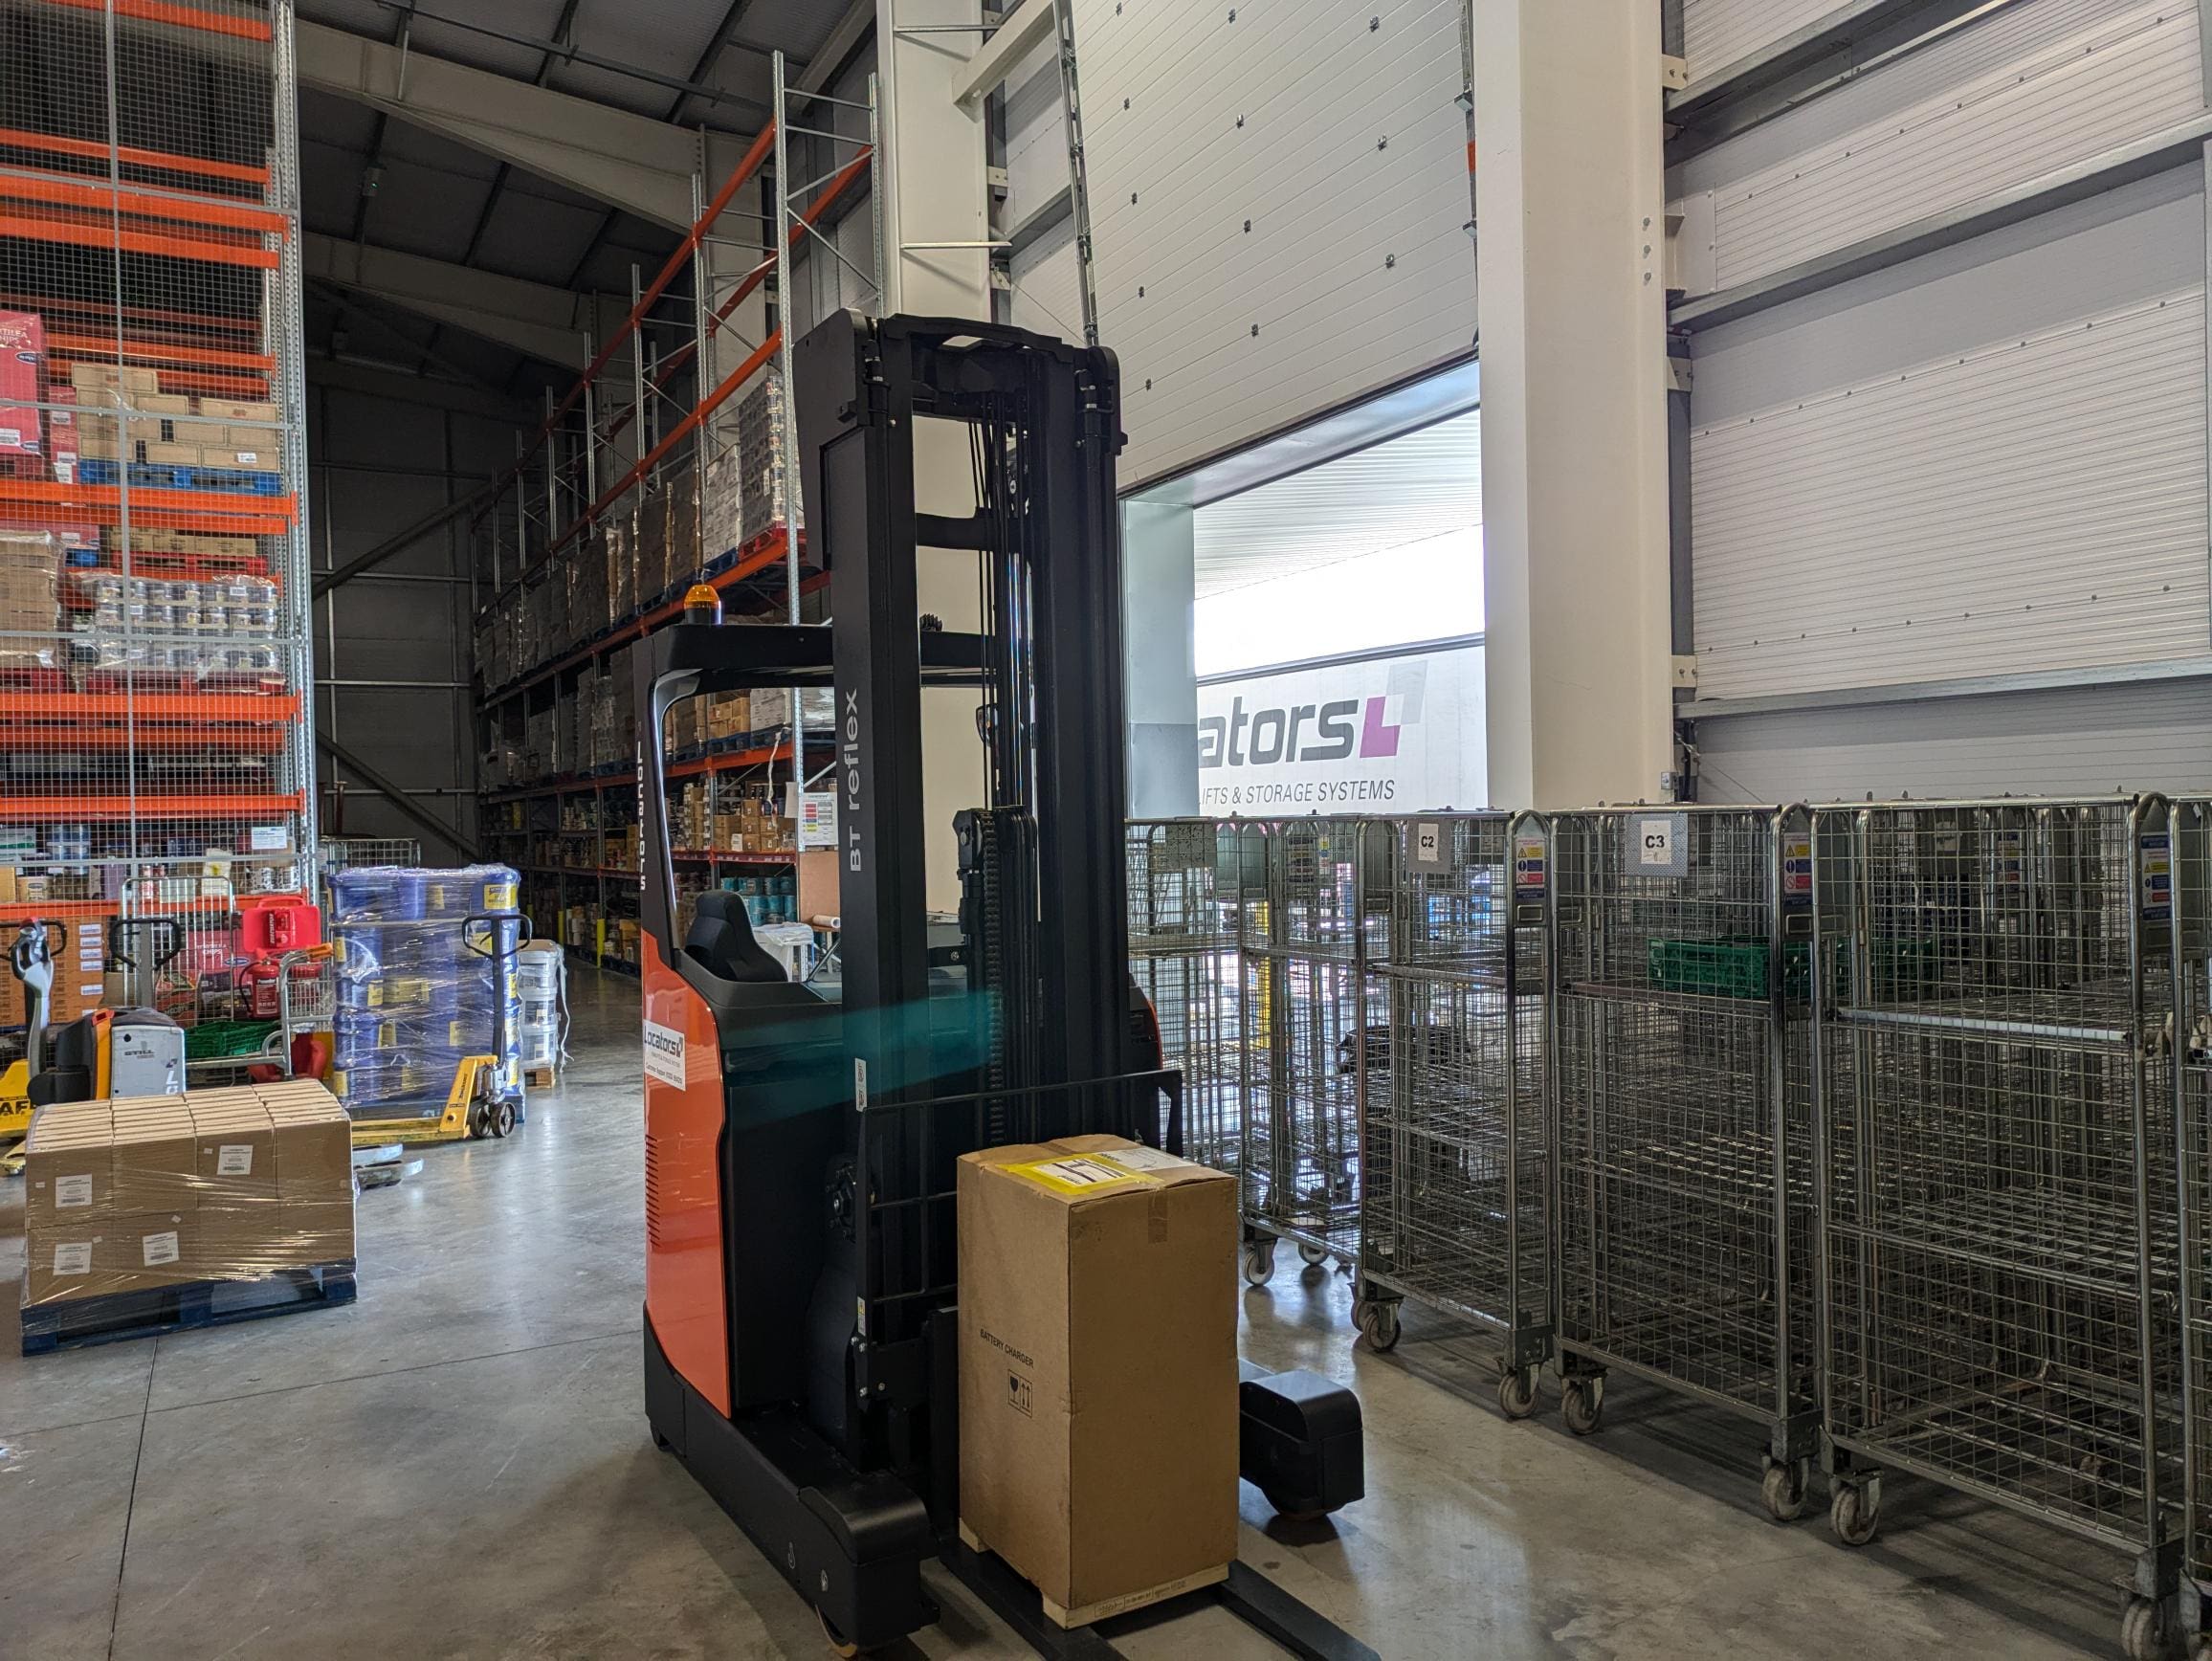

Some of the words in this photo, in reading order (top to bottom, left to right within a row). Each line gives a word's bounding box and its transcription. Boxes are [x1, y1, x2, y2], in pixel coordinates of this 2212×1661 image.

[844, 688, 860, 810] reflex
[1200, 786, 1228, 805] IFTS
[1231, 786, 1242, 804] &
[1246, 783, 1314, 804] STORAGE
[1317, 780, 1395, 801] SYSTEMS
[637, 741, 646, 891] Locators
[850, 826, 862, 872] BT
[1421, 835, 1434, 848] C2
[1645, 834, 1665, 849] C3
[644, 1025, 676, 1055] Locators
[980, 1328, 1005, 1350] BATTERY
[1005, 1344, 1034, 1369] CHARGER
